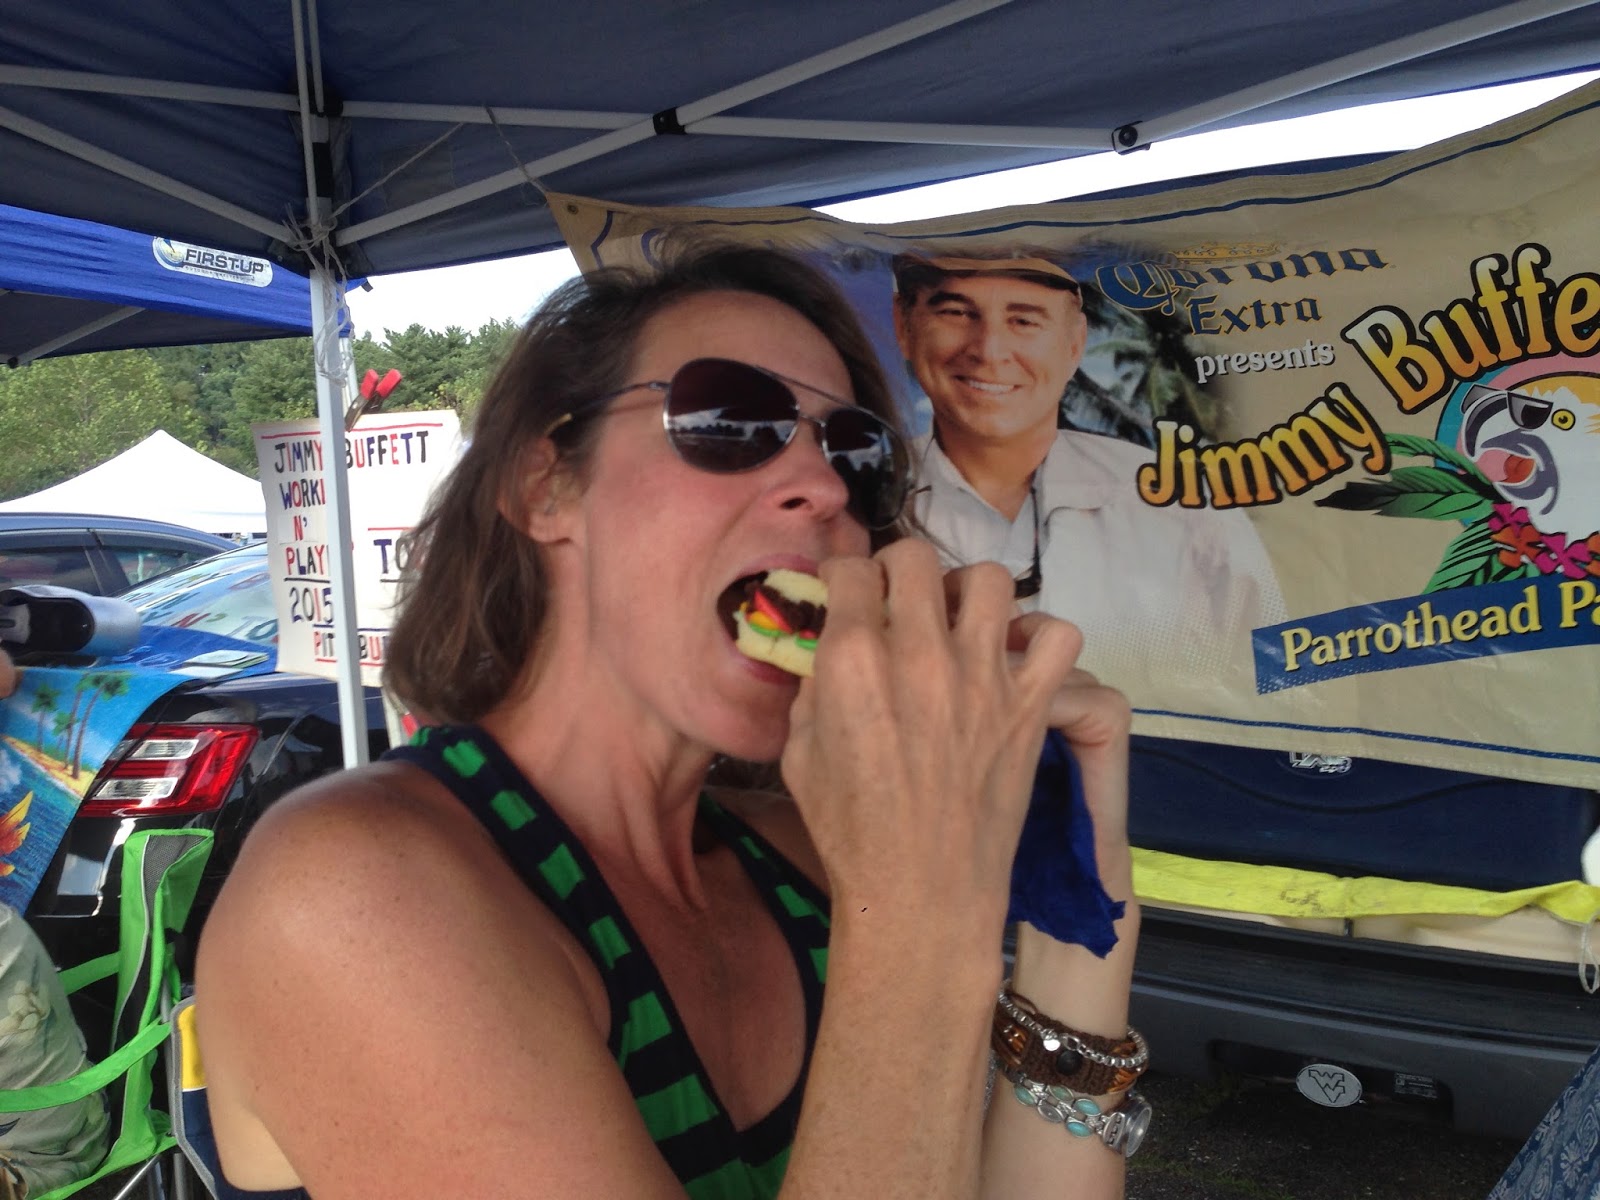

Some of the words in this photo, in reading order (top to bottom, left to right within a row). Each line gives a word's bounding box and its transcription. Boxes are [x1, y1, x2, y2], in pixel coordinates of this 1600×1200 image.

[1096, 247, 1390, 316] Corona
[1186, 294, 1323, 336] Extra
[1137, 382, 1392, 509] Jimmy
[1340, 242, 1600, 415] Buffe
[1194, 339, 1335, 384] presents
[274, 439, 324, 474] JIMMY
[345, 430, 429, 469] BUFFETT
[288, 586, 334, 624] 2015
[1280, 584, 1542, 673] Parrothead
